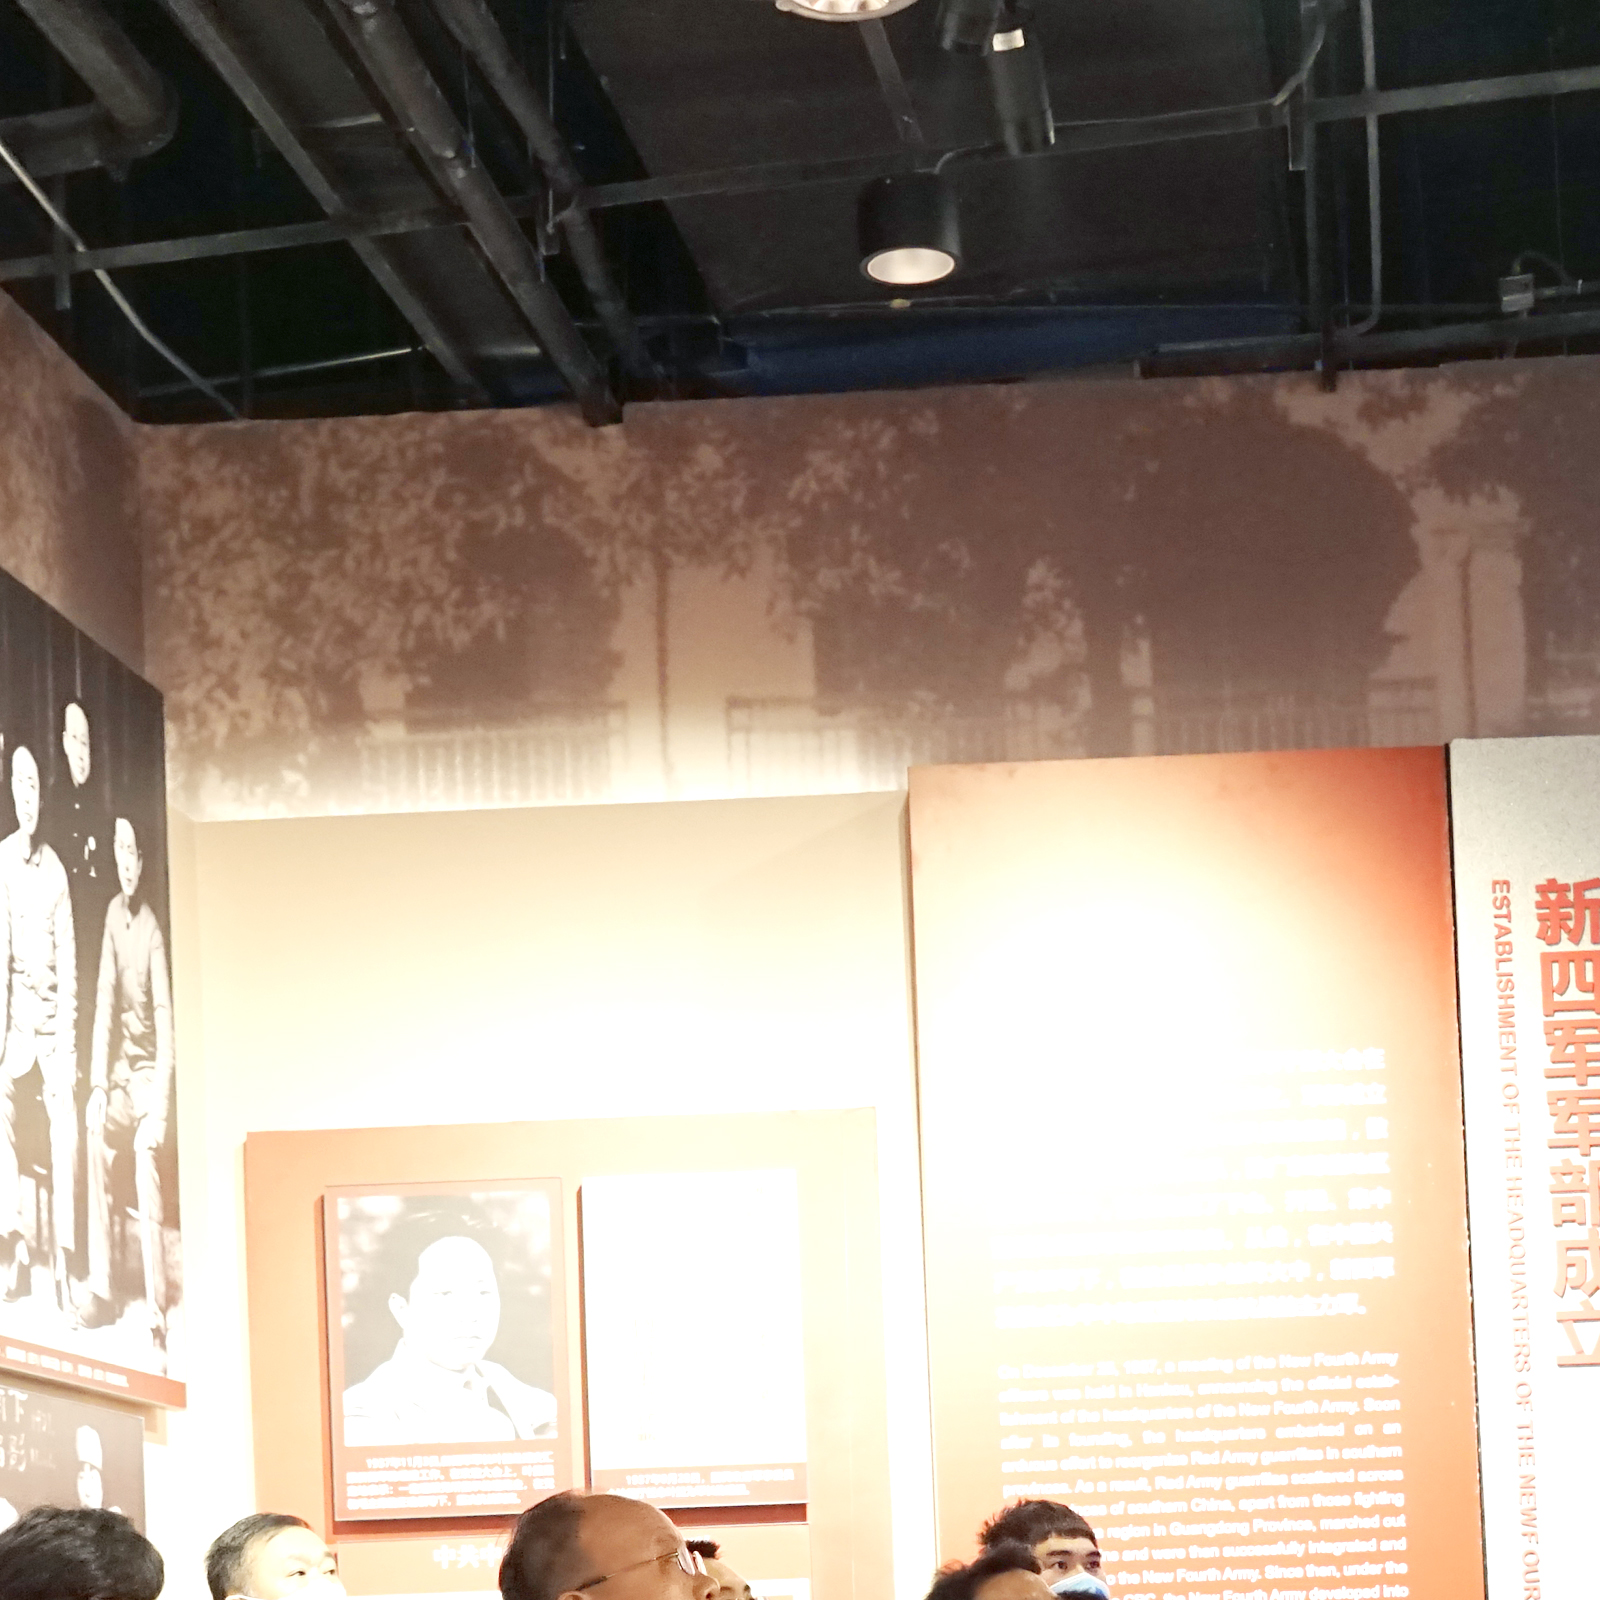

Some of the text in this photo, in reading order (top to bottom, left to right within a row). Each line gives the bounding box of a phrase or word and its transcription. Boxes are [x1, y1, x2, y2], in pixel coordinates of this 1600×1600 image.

[1490, 879, 1518, 1076] ESTABLISHMENT
[1499, 1081, 1519, 1114] OF
[1502, 1123, 1522, 1169] THE
[1505, 1177, 1531, 1373] HEADQUARTERS
[1236, 1354, 1251, 1371] of
[1279, 1354, 1311, 1369] New
[1314, 1351, 1359, 1368] Fourth
[1361, 1351, 1398, 1367] Army
[1281, 1377, 1304, 1392] the
[1513, 1381, 1533, 1412] OF
[1060, 1408, 1075, 1424] of
[1196, 1403, 1211, 1419] of
[1239, 1402, 1270, 1417] New
[1273, 1400, 1318, 1416] Fourth
[1320, 1398, 1360, 1415] Army.
[1354, 1423, 1373, 1436] on
[1190, 1450, 1220, 1465] Red
[1221, 1449, 1258, 1466] Army
[1326, 1445, 1340, 1460] in
[1515, 1421, 1535, 1467] THE
[1154, 1475, 1184, 1490] Red
[1185, 1474, 1222, 1492] Army
[1110, 1500, 1124, 1515] of
[1127, 1499, 1187, 1515] southern
[1190, 1497, 1235, 1513] China,
[1277, 1494, 1309, 1509] from
[1312, 1493, 1351, 1508] those
[1354, 1490, 1404, 1509] fighting
[1107, 1524, 1150, 1541] region
[1153, 1523, 1166, 1537] in
[1169, 1519, 1249, 1538] Guangdong
[1253, 1518, 1316, 1533] Province,
[1320, 1513, 1380, 1531] marched
[1383, 1513, 1406, 1528] out
[1122, 1546, 1148, 1562] and
[1151, 1547, 1186, 1560] were
[1188, 1544, 1219, 1559] then
[1223, 1540, 1305, 1558] successfully
[1308, 1537, 1376, 1556] integrated
[1380, 1536, 1407, 1551] and
[1118, 1570, 1140, 1585] the
[1142, 1569, 1174, 1584] New
[1176, 1567, 1221, 1583] Fourth
[1222, 1566, 1261, 1583] Army.
[1264, 1564, 1303, 1580] Since
[1305, 1563, 1340, 1578] then,
[1343, 1561, 1383, 1577] under
[1385, 1560, 1408, 1575] the
[1383, 1584, 1409, 1598] into
